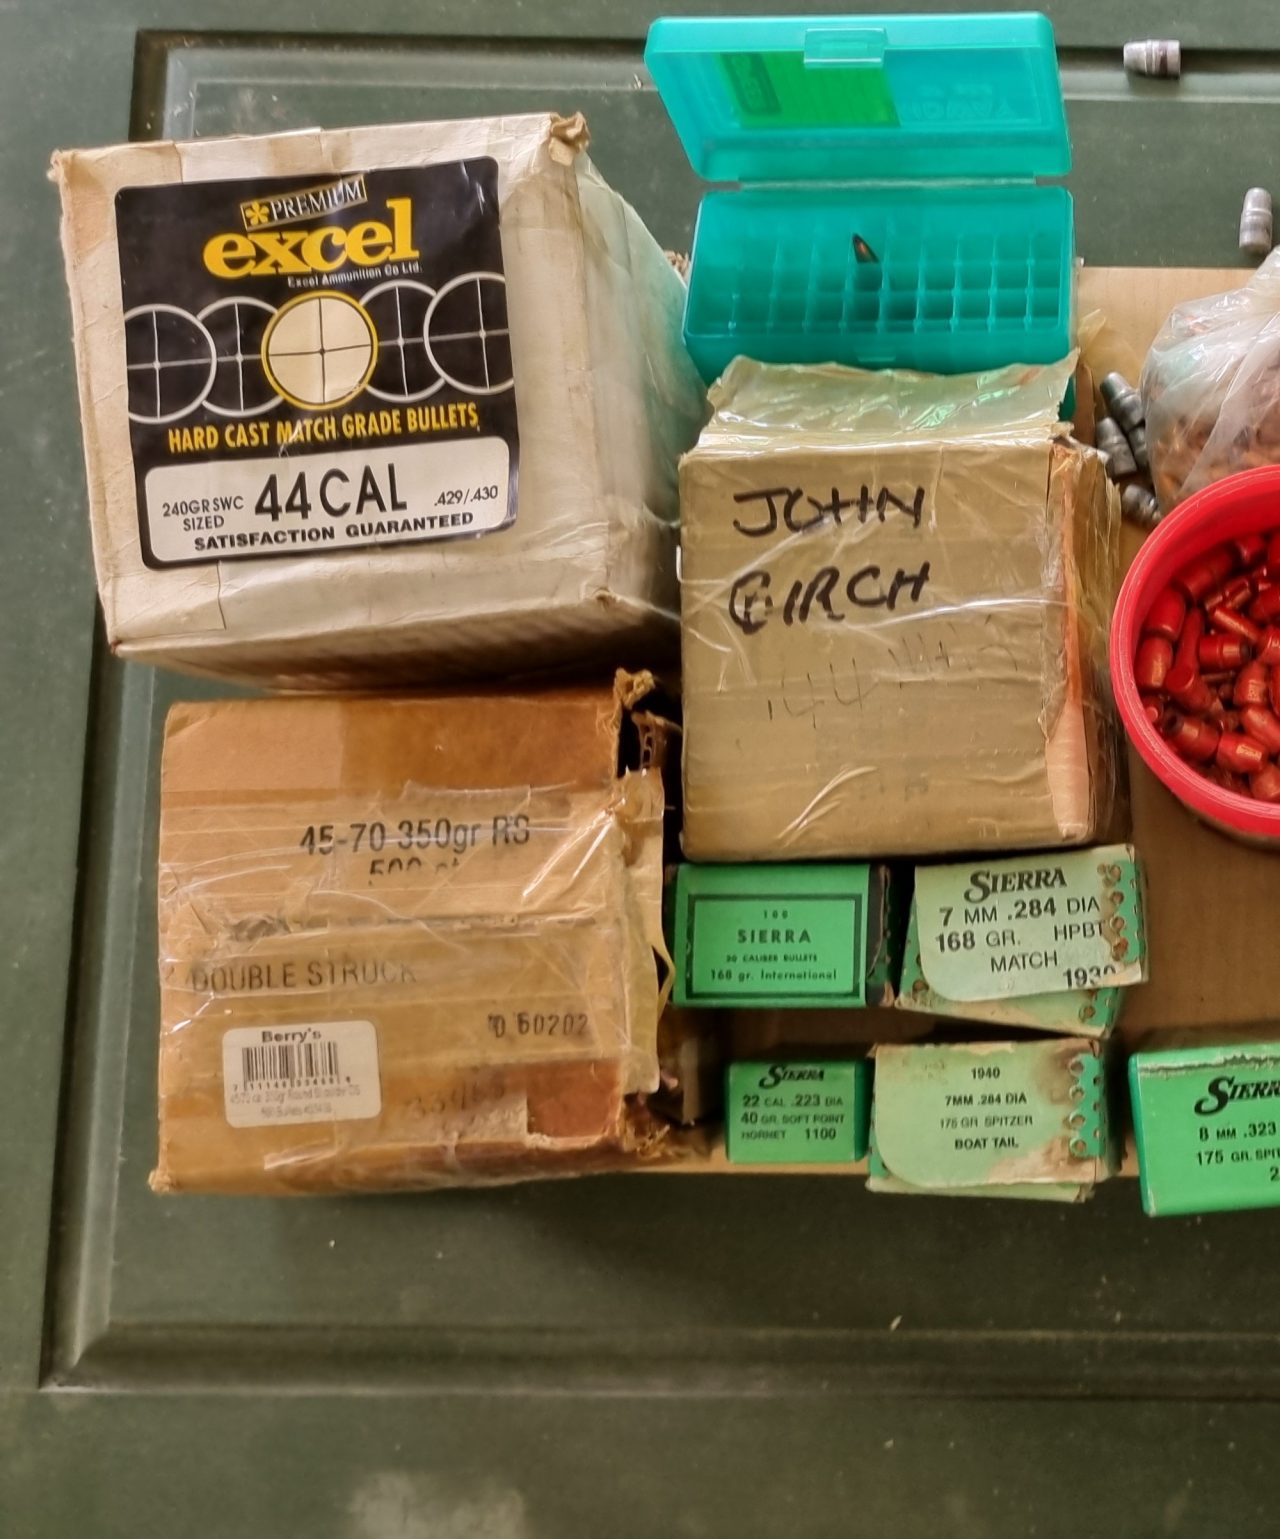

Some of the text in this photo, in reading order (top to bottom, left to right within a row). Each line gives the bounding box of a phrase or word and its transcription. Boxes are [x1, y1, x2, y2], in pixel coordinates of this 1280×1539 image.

[270, 180, 361, 221] PREMIUM
[203, 198, 420, 278] excel
[287, 275, 318, 289] Excel
[322, 268, 382, 286] Ammunition
[384, 266, 399, 276] Co
[168, 425, 219, 453] HARD
[225, 421, 269, 448] CAST
[277, 414, 337, 445] MATCH
[342, 409, 401, 438] GRADE
[213, 495, 244, 512] SWC
[733, 484, 925, 537] JOHN
[183, 515, 225, 531] SIZED
[194, 512, 473, 551] SATISFACTION GUARANTEED
[300, 822, 386, 856] 45-70
[398, 817, 481, 854] 350gr
[939, 896, 1100, 927] 7 MM .284 DIA
[737, 929, 812, 944] SIERRA
[936, 919, 1105, 953] 168 GR. HPBT
[742, 954, 778, 963] CALIBER
[783, 954, 818, 963] BULLETS
[991, 950, 1058, 973] MATCH
[191, 956, 416, 992] DOUBLE STRUCK
[760, 968, 837, 981] International
[261, 1027, 322, 1043] Berry's
[971, 1066, 1001, 1080] 1940
[742, 1094, 760, 1107] 22
[825, 1096, 843, 1106] DIA
[945, 1094, 974, 1107] 7MM
[1005, 1091, 1028, 1105] DIA
[741, 1112, 758, 1124] 40
[782, 1114, 809, 1124] SOFT
[813, 1113, 845, 1124] POINT
[984, 1115, 1033, 1128] SPITZER
[741, 1128, 836, 1140] HORNET 1100
[1199, 1126, 1209, 1141] 8
[1216, 1127, 1236, 1140] MM
[1243, 1121, 1277, 1138] .323
[954, 1136, 1019, 1150] BOAT TAIL
[1197, 1149, 1224, 1166] 175
